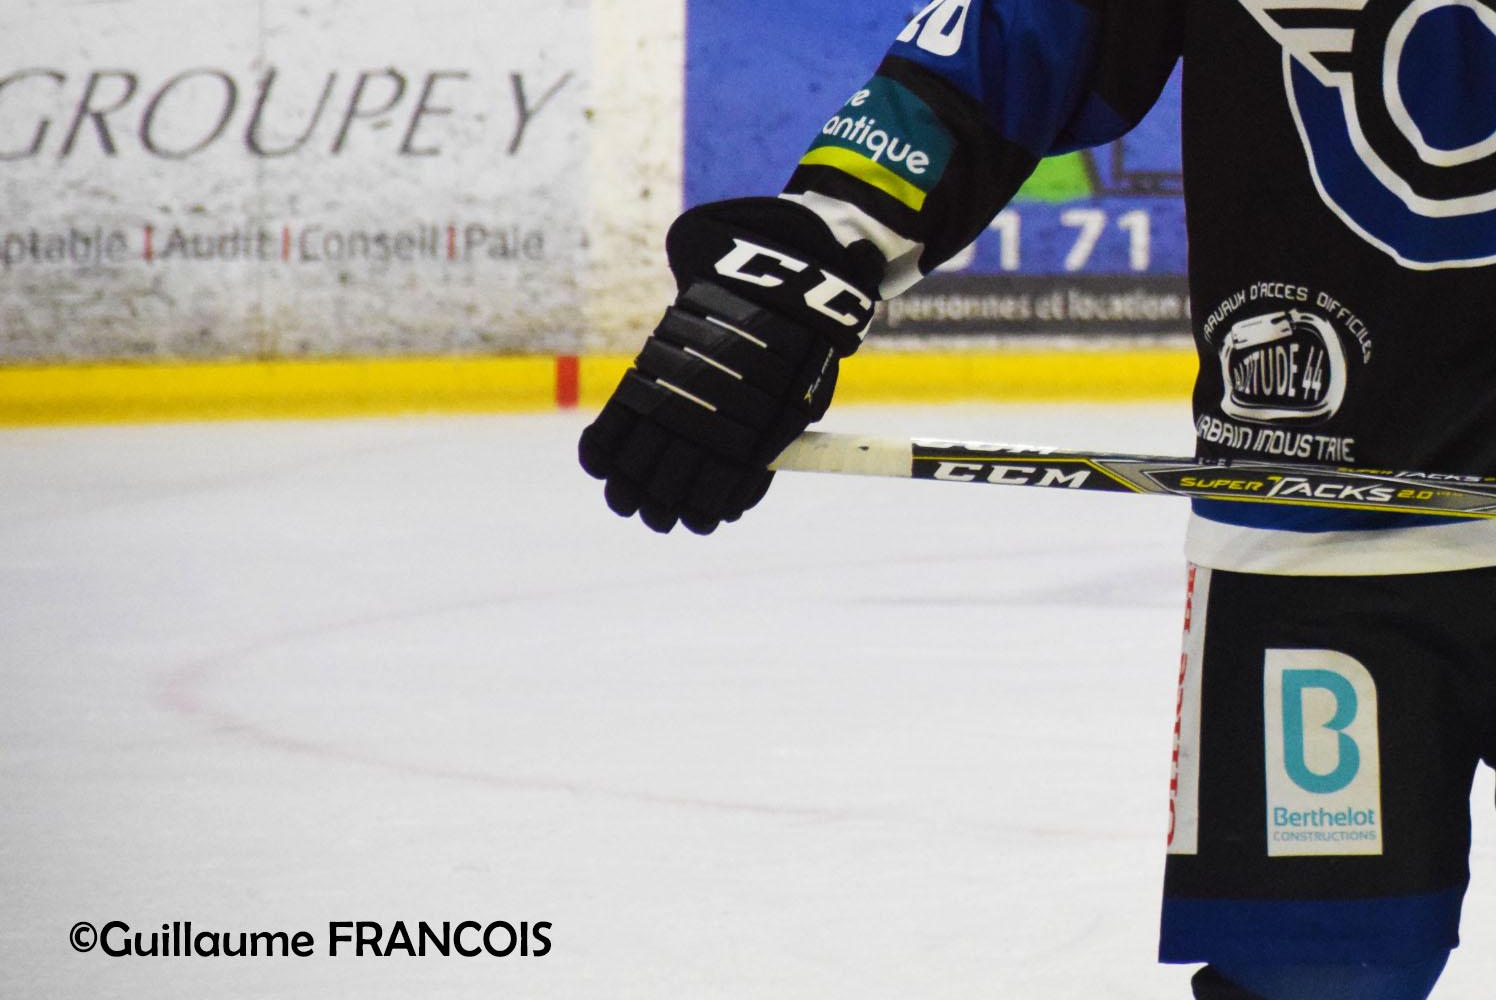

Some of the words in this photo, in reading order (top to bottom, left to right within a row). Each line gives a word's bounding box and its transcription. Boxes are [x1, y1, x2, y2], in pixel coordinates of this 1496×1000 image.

[0, 67, 470, 161] GROUPE
[506, 71, 575, 155] Y
[158, 226, 272, 260] Audit
[301, 223, 440, 262] Conseil
[1060, 208, 1150, 272] 71
[714, 237, 873, 342] CC
[1205, 289, 1247, 344] RAVAUX
[932, 461, 1091, 489] CCM
[1179, 476, 1264, 492] SUPER
[1266, 475, 1395, 503] TACKS
[1397, 489, 1434, 501] 2.0
[1272, 830, 1377, 842] CONSTRUCTIONS
[1273, 806, 1375, 827] Berthelot
